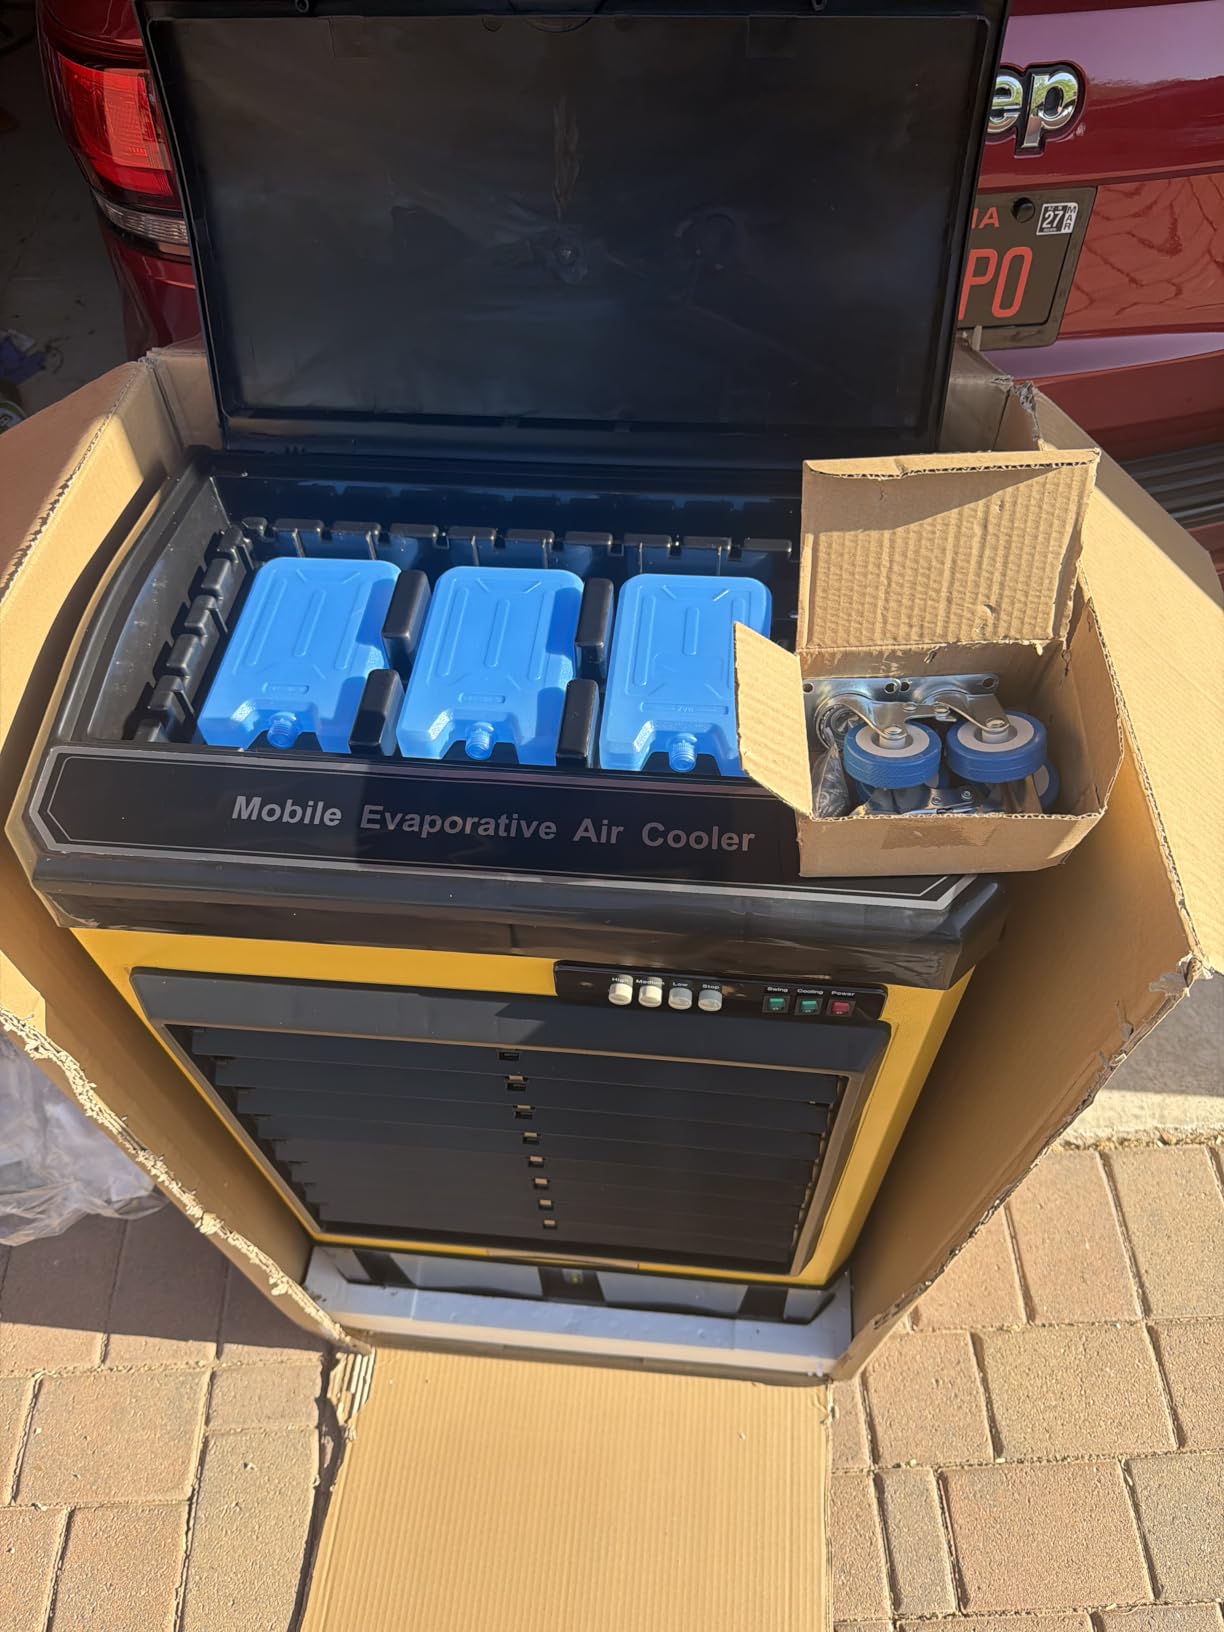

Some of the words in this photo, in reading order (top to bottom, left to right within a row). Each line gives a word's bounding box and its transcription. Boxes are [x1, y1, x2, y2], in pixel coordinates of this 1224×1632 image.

[986, 72, 1078, 148] ep
[971, 207, 1000, 229] IA
[1042, 211, 1064, 228] 27
[1063, 205, 1077, 231] MAR
[957, 246, 1033, 320] PO
[232, 795, 342, 826] Mobile
[360, 804, 557, 840] Evaporative
[572, 818, 624, 844] Air
[641, 821, 756, 852] Cooler
